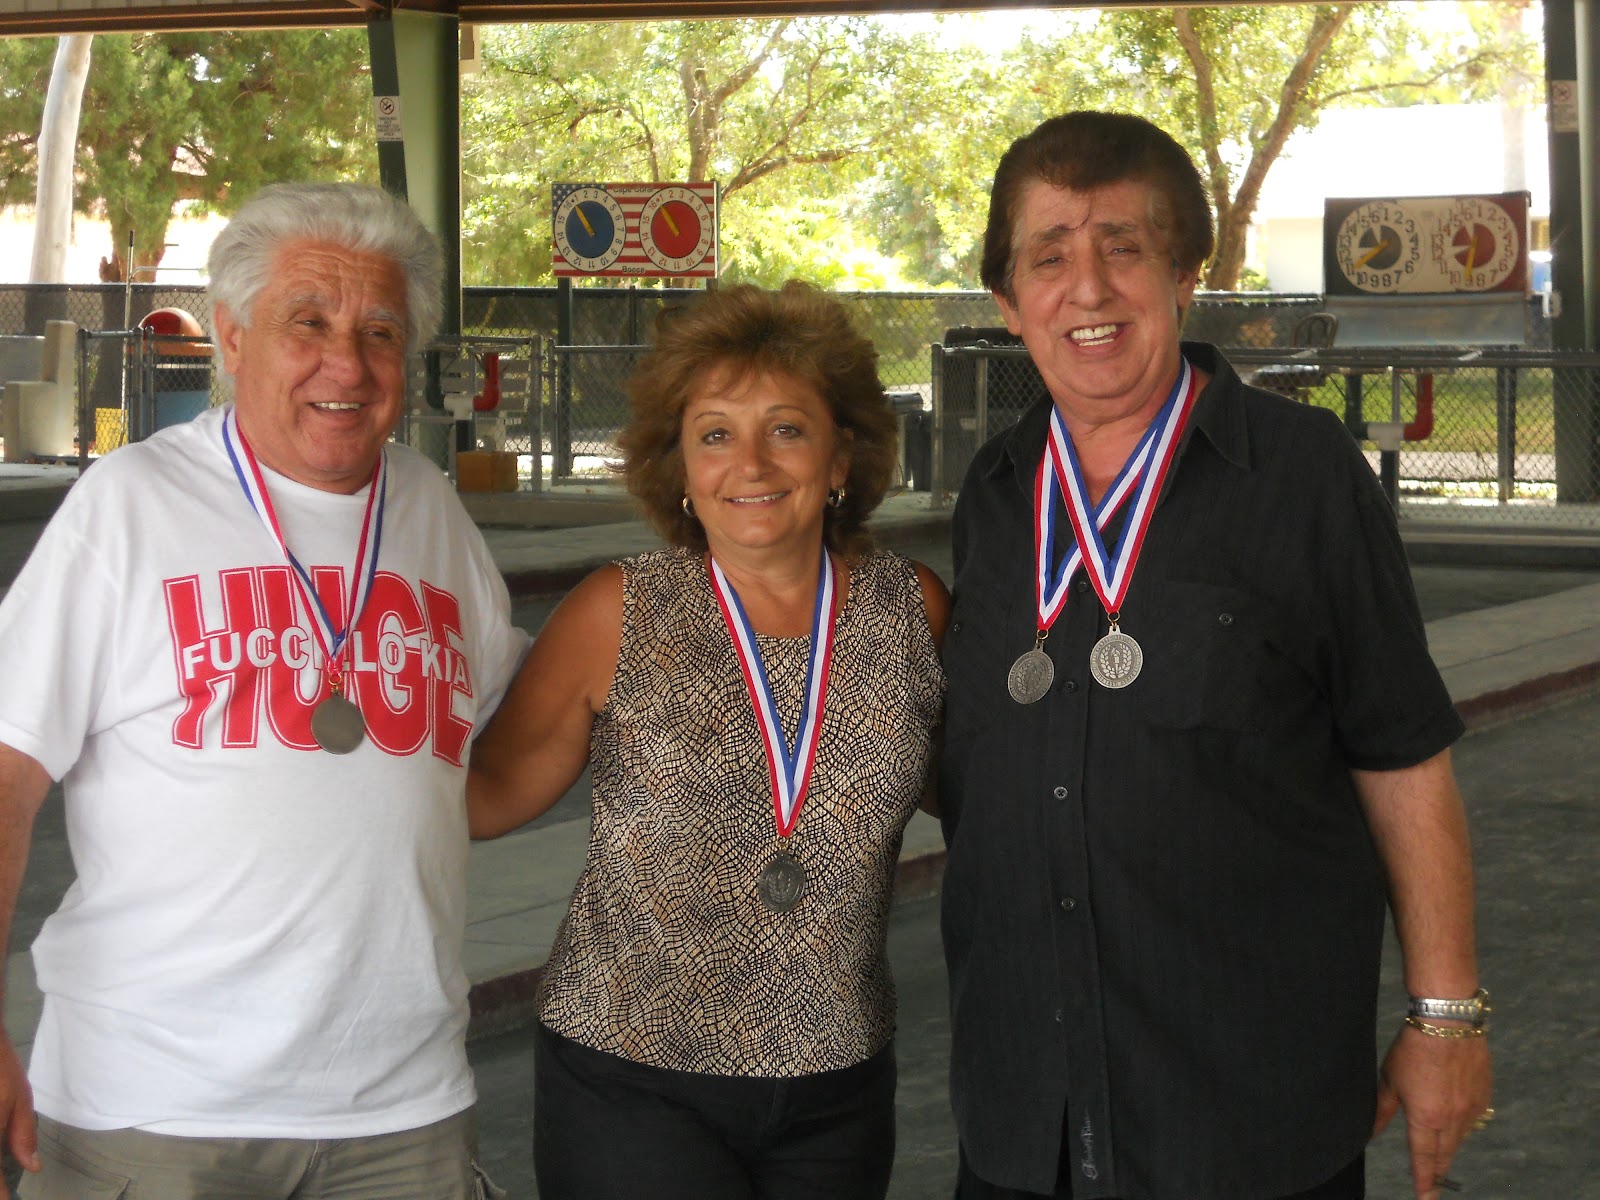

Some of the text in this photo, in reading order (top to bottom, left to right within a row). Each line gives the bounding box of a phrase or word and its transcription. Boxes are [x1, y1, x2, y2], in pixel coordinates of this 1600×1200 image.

[564, 201, 572, 210] 16
[1478, 204, 1482, 218] 1
[558, 215, 565, 224] 15
[643, 215, 650, 224] 15
[1384, 208, 1388, 221] 1
[1394, 211, 1403, 224] 2
[1487, 207, 1496, 221] 2
[1405, 219, 1414, 233] 3
[557, 232, 565, 240] 14
[642, 232, 649, 241] 14
[563, 246, 571, 256] 13
[648, 247, 656, 256] 13
[1410, 247, 1420, 260] 5
[1504, 245, 1514, 258] 5
[574, 257, 582, 265] 12
[589, 261, 595, 269] 11
[600, 257, 609, 266] 10
[659, 257, 667, 266] 12
[674, 261, 680, 269] 11
[686, 257, 694, 266] 10
[1405, 260, 1414, 274] 6
[1499, 258, 1508, 272] 6
[622, 265, 646, 274] Bocce
[1490, 269, 1498, 282] 7
[1356, 272, 1368, 285] 10
[1370, 274, 1379, 287] 9
[1382, 273, 1391, 287] 8
[1394, 270, 1403, 284] 7
[1449, 270, 1461, 284] 10
[1477, 273, 1485, 287] 8
[183, 627, 472, 693] FUCCILO KIA
[163, 566, 474, 768] HUGE
